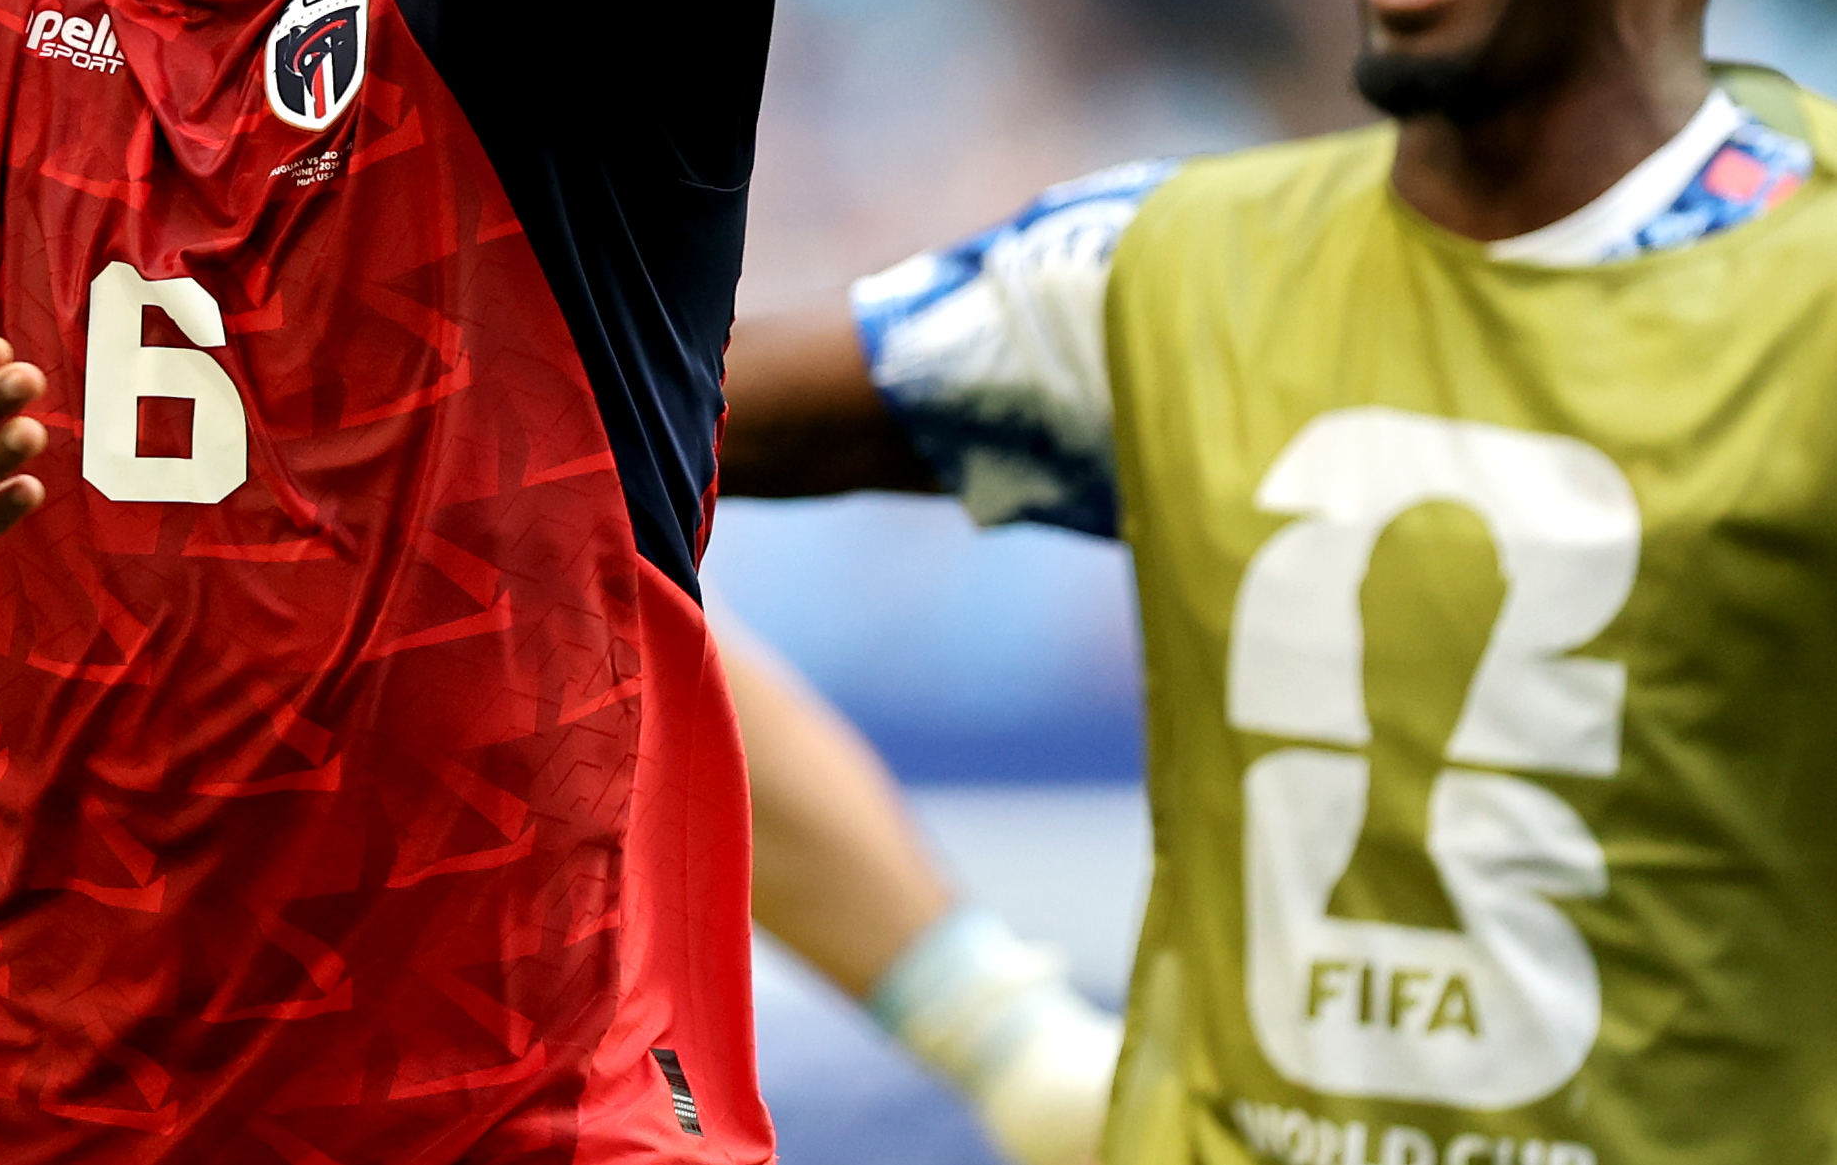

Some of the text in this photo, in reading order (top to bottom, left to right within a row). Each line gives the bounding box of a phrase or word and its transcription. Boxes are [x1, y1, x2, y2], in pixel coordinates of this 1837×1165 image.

[39, 42, 125, 74] SPORT
[82, 260, 248, 504] 6
[1305, 959, 1482, 1037] FIFA
[1232, 1097, 1438, 1165] WORLD
